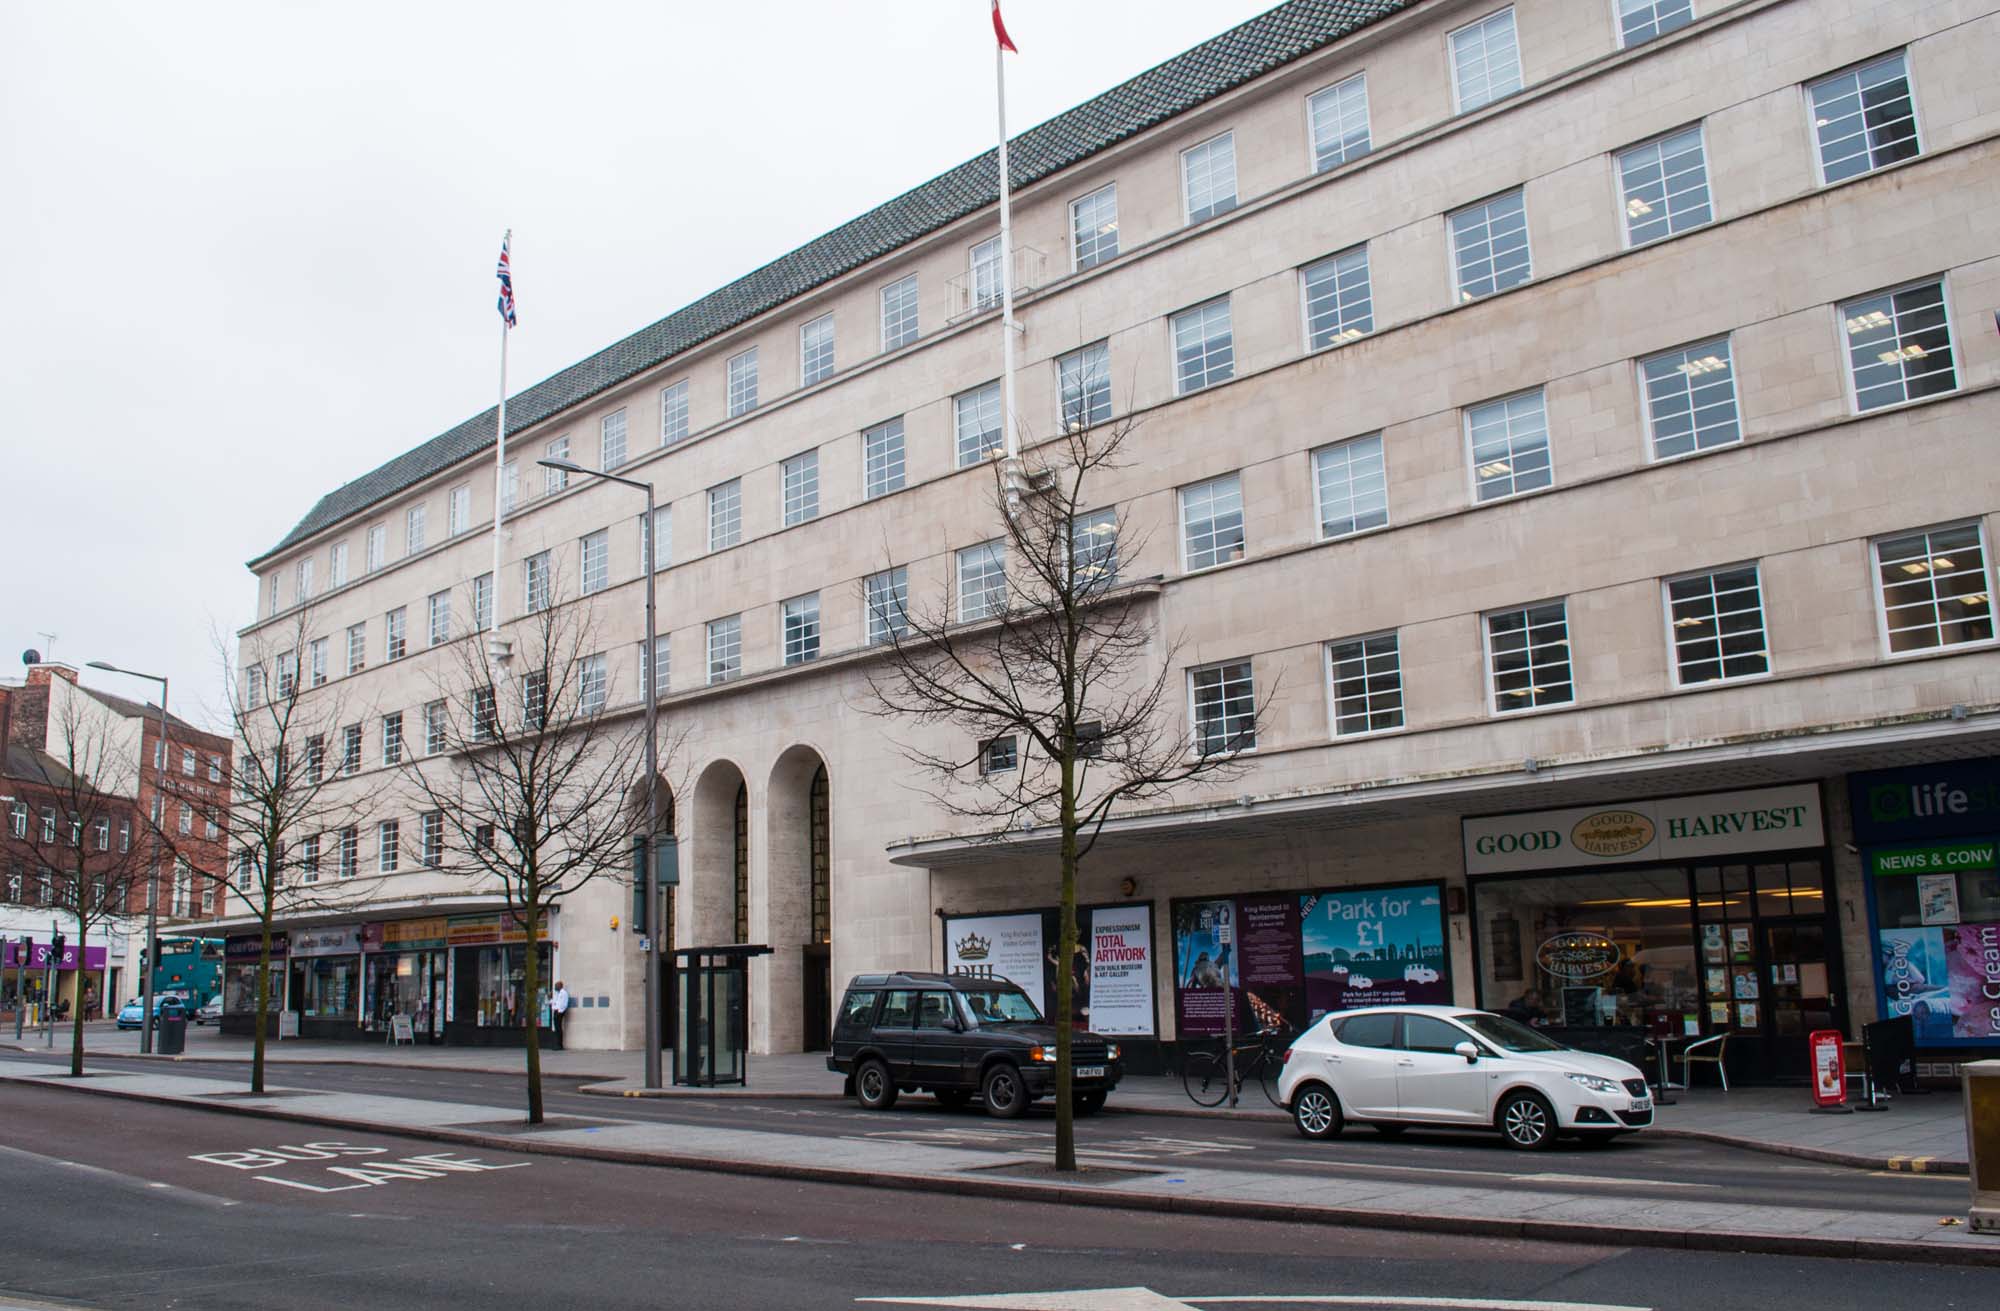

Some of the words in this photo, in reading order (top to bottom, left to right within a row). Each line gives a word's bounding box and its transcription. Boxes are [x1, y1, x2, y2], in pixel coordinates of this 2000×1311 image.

[1476, 831, 1562, 856] GOOD
[1668, 806, 1807, 840] HARVEST
[1589, 813, 1634, 828] GOOD
[1583, 837, 1645, 854] HARVEST
[1879, 854, 1927, 870] NEWS
[1931, 852, 1943, 867] &
[1946, 848, 1993, 865] CONV
[1300, 895, 1318, 919] NEW
[1327, 898, 1375, 921] Park
[1380, 896, 1412, 918] for
[1095, 924, 1140, 933] EXPRESSIONISM
[1356, 920, 1385, 946] £1
[1095, 935, 1126, 948] TOTAL
[1095, 948, 1146, 961] ARTWORK
[1982, 925, 1999, 1000] Cream
[1109, 969, 1129, 977] GALLERY
[1895, 939, 1913, 1016] Grocery
[1988, 1007, 2000, 1037] Ice
[187, 1142, 389, 1170] BUS
[251, 1153, 533, 1193] LANE
